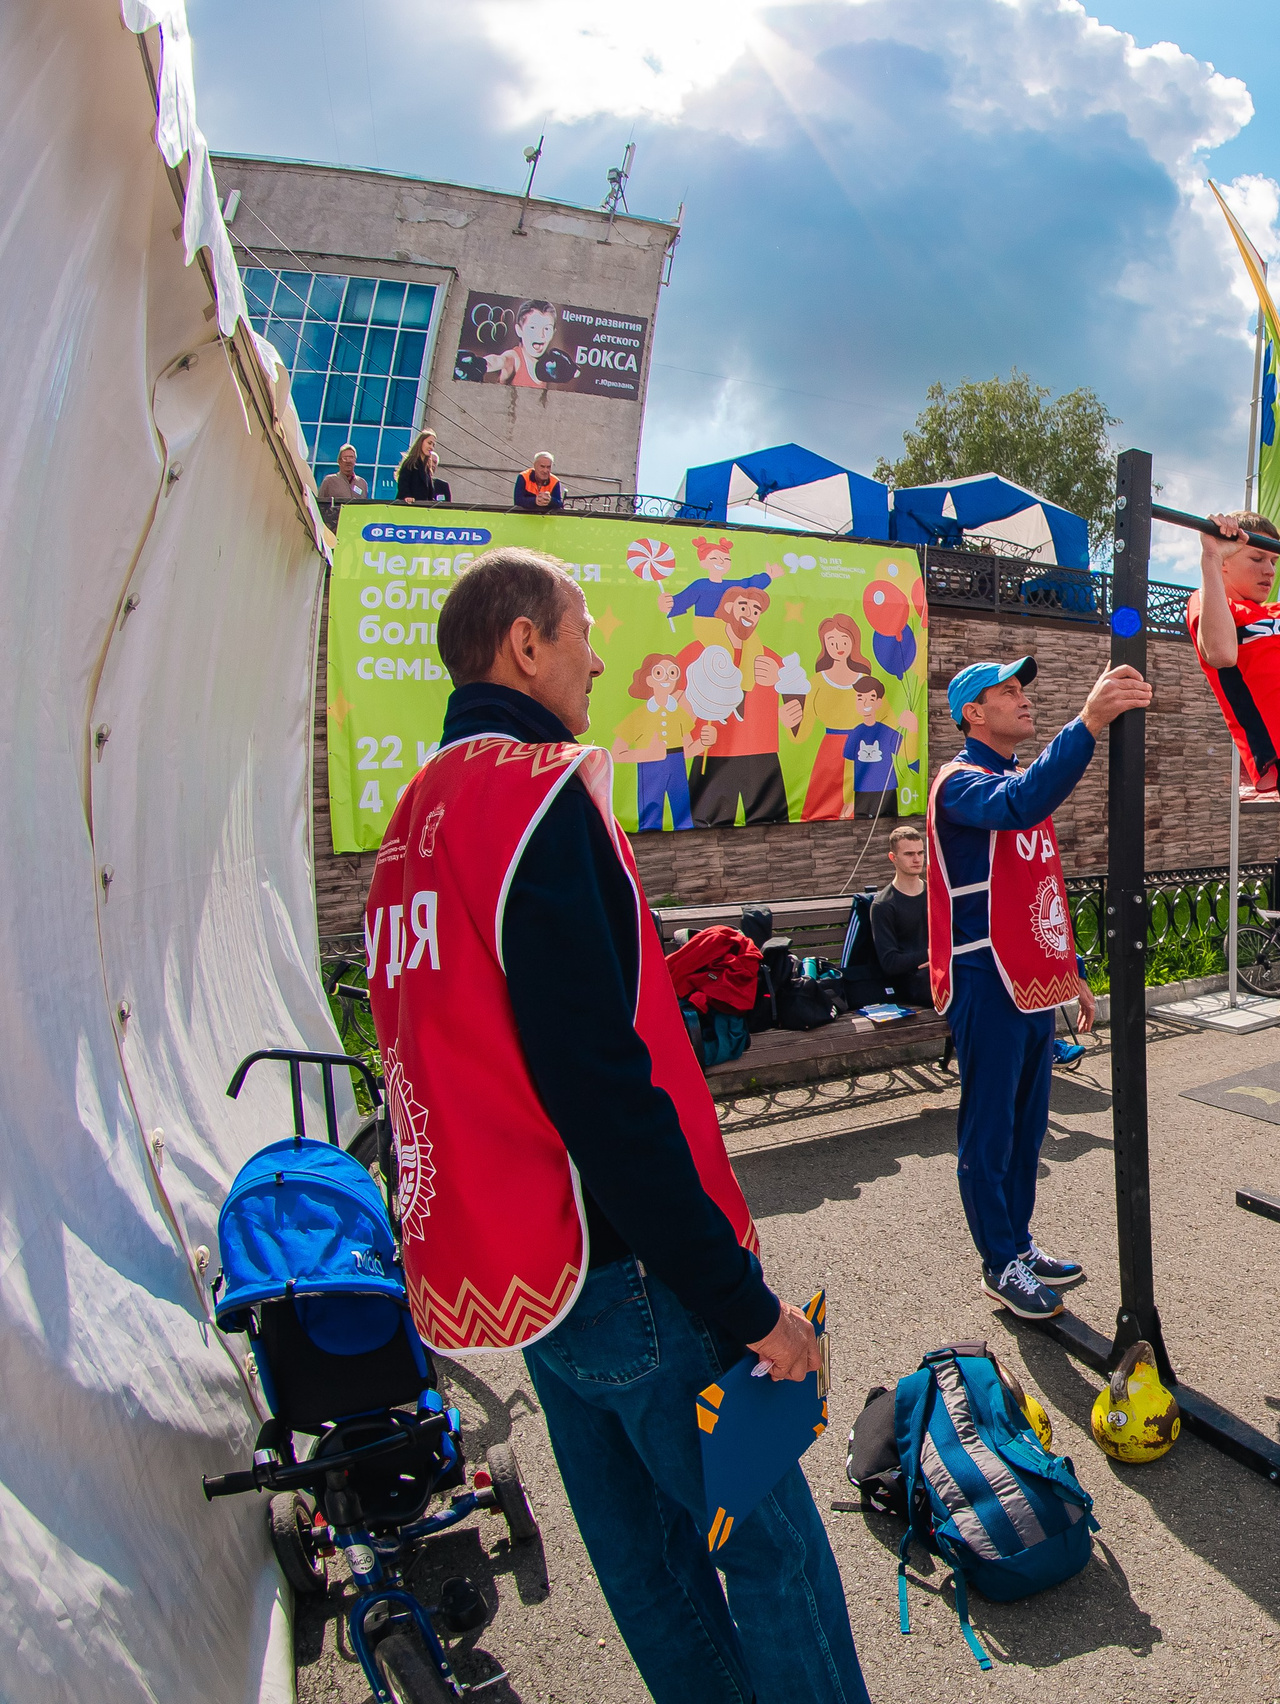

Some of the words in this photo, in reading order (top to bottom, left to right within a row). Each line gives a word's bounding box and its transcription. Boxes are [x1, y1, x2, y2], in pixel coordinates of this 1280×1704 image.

[562, 310, 594, 326] Центр
[595, 317, 642, 332] развития
[592, 333, 640, 348] детского
[575, 345, 638, 373] БОКСА
[370, 527, 484, 542] ФЕСТИВАЛЬ
[357, 656, 450, 681] семь
[357, 736, 403, 770] 22
[359, 780, 383, 813] 4
[900, 787, 919, 805] 0+
[365, 890, 441, 989] УДЯ
